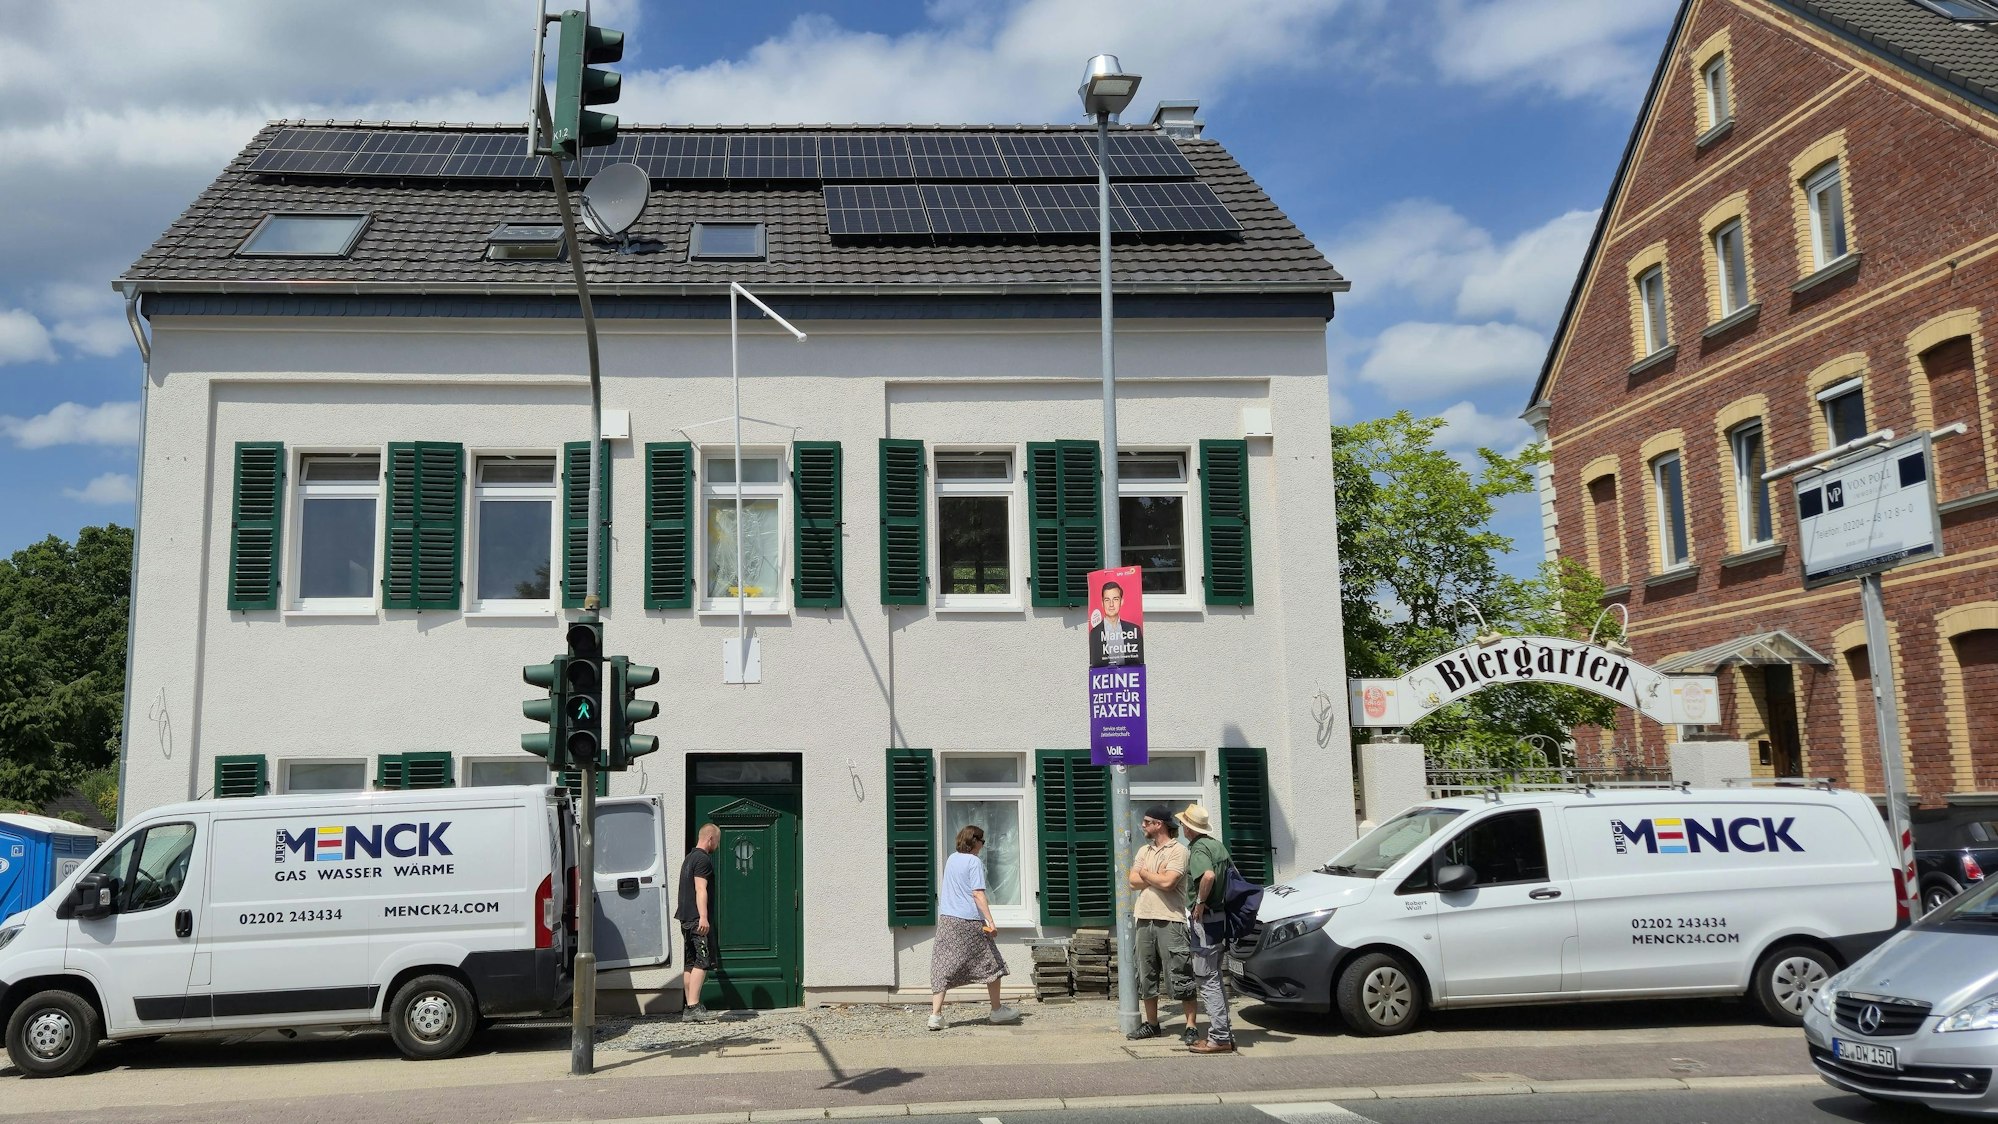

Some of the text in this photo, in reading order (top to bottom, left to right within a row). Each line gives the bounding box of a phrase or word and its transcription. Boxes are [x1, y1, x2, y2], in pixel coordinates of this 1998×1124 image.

[1847, 476, 1866, 490] VON
[1828, 487, 1842, 503] VP
[1101, 628, 1138, 642] Marcel
[1102, 643, 1139, 655] Kreutz
[1434, 640, 1629, 693] Biergarten
[1093, 672, 1140, 689] KEINE
[1093, 689, 1140, 704] ZEIT FÜR
[1093, 703, 1140, 718] FAXEN
[1106, 745, 1123, 755] Volt
[284, 821, 453, 862] MENCK
[1610, 819, 1627, 854] ULRICH
[1619, 817, 1805, 853] MENCK
[275, 829, 286, 863] ULRICH
[274, 862, 455, 882] GAS WASSER WÄRME
[239, 909, 343, 925] 02202 243434
[384, 902, 499, 917] MENCK24.COM
[1632, 917, 1727, 929] 02202 243434
[1632, 933, 1739, 945] MENCK24.COM
[1839, 1042, 1849, 1058] GL
[1871, 1048, 1893, 1066] 150
